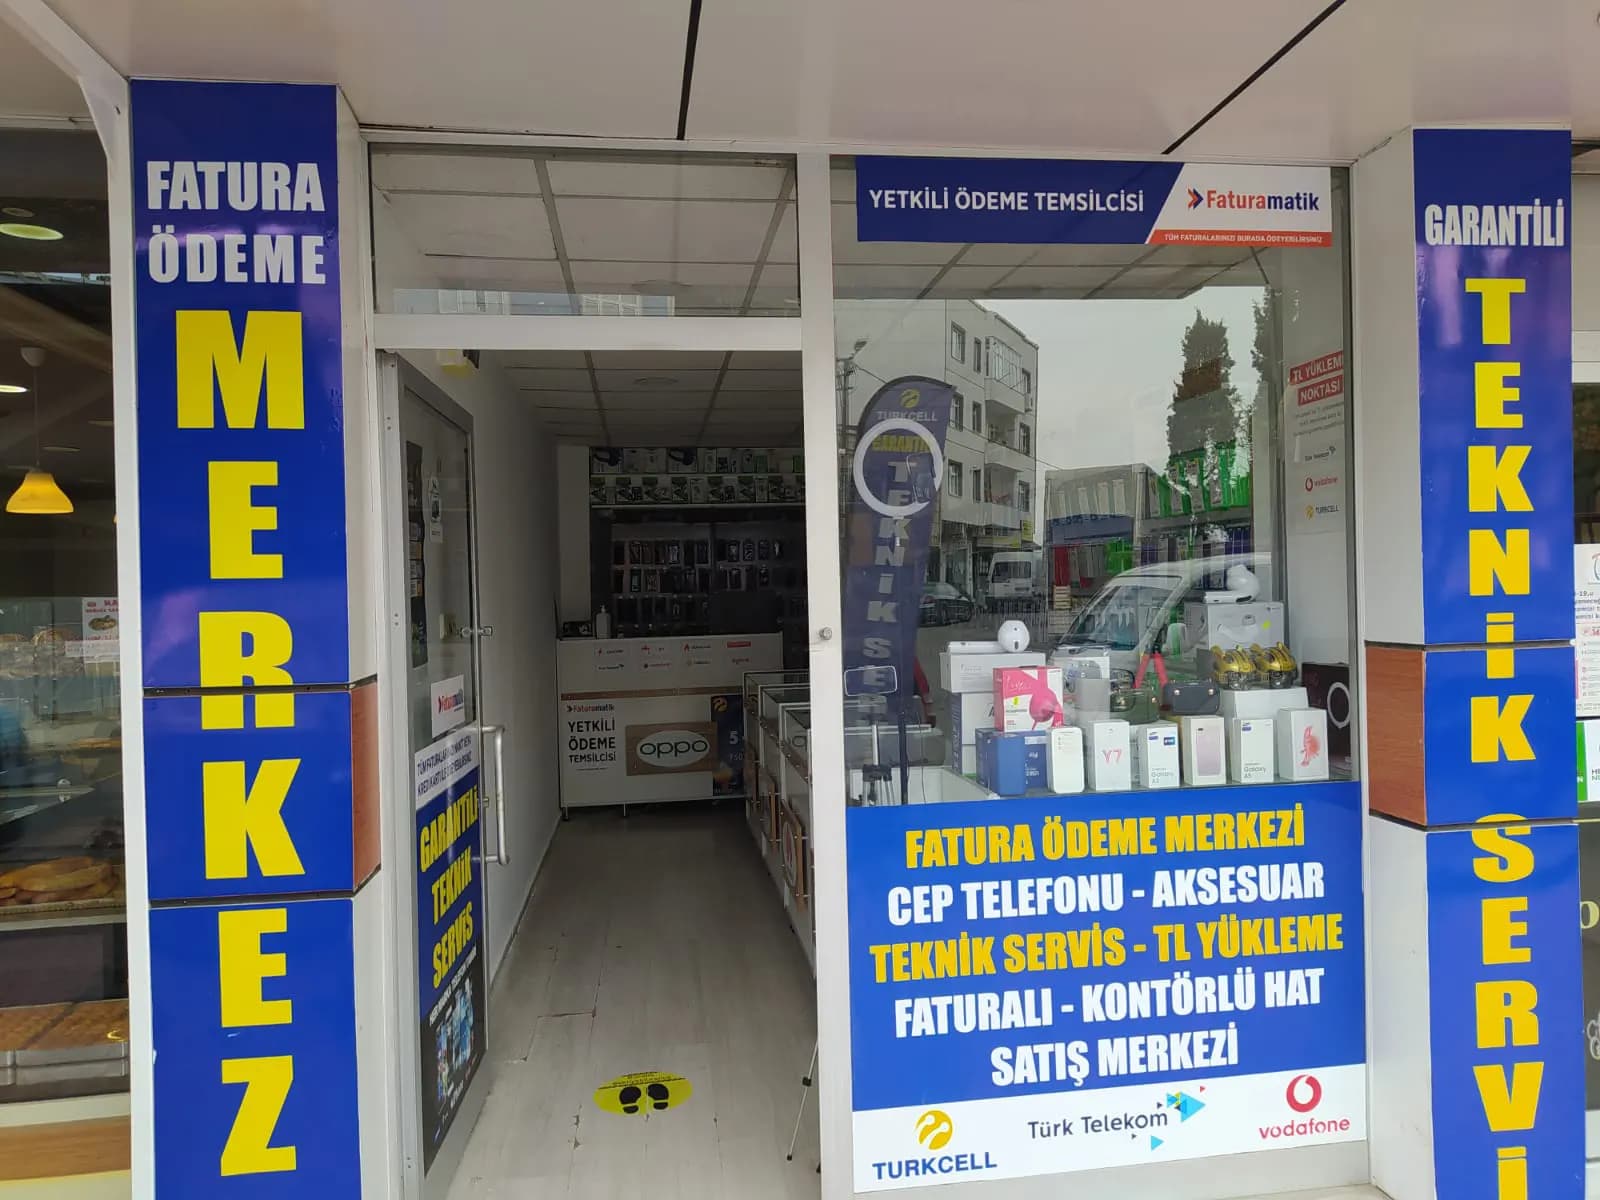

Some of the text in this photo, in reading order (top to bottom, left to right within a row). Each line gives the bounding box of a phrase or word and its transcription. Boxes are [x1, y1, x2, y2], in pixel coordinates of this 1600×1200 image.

[146, 160, 326, 212] FATURA
[868, 186, 1145, 213] YETKİLİ ÖDEME TEMSİLCİSİ
[1206, 189, 1320, 211] Faturamatik
[1424, 198, 1565, 247] GARANTİLİ
[147, 224, 326, 285] ÖDEME
[1300, 378, 1341, 403] NOKTASI
[174, 309, 306, 1177] MERKEZ
[567, 718, 615, 733] YETKİLİ
[568, 736, 616, 750] ÖDEME
[905, 802, 1306, 869] FATURA ÖDEME MERKEZİ
[887, 881, 955, 927] CEP
[961, 873, 1124, 921] TELEFONU
[1152, 861, 1325, 909] AKSESUAR
[869, 931, 997, 984] TEKNİK
[1003, 923, 1127, 973] SERVİS
[1153, 924, 1192, 964] TL
[1194, 913, 1345, 960] YÜKLEME
[893, 987, 1053, 1039] FATURALI
[1082, 966, 1258, 1024] KONTÖRLÜ
[1263, 967, 1326, 1009] HAT
[990, 1021, 1239, 1087] SATIŞ MERKEZİ
[1027, 1109, 1169, 1141] Türk Telekom
[1258, 1115, 1351, 1140] vodafone
[872, 1151, 998, 1182] TURKCELL
